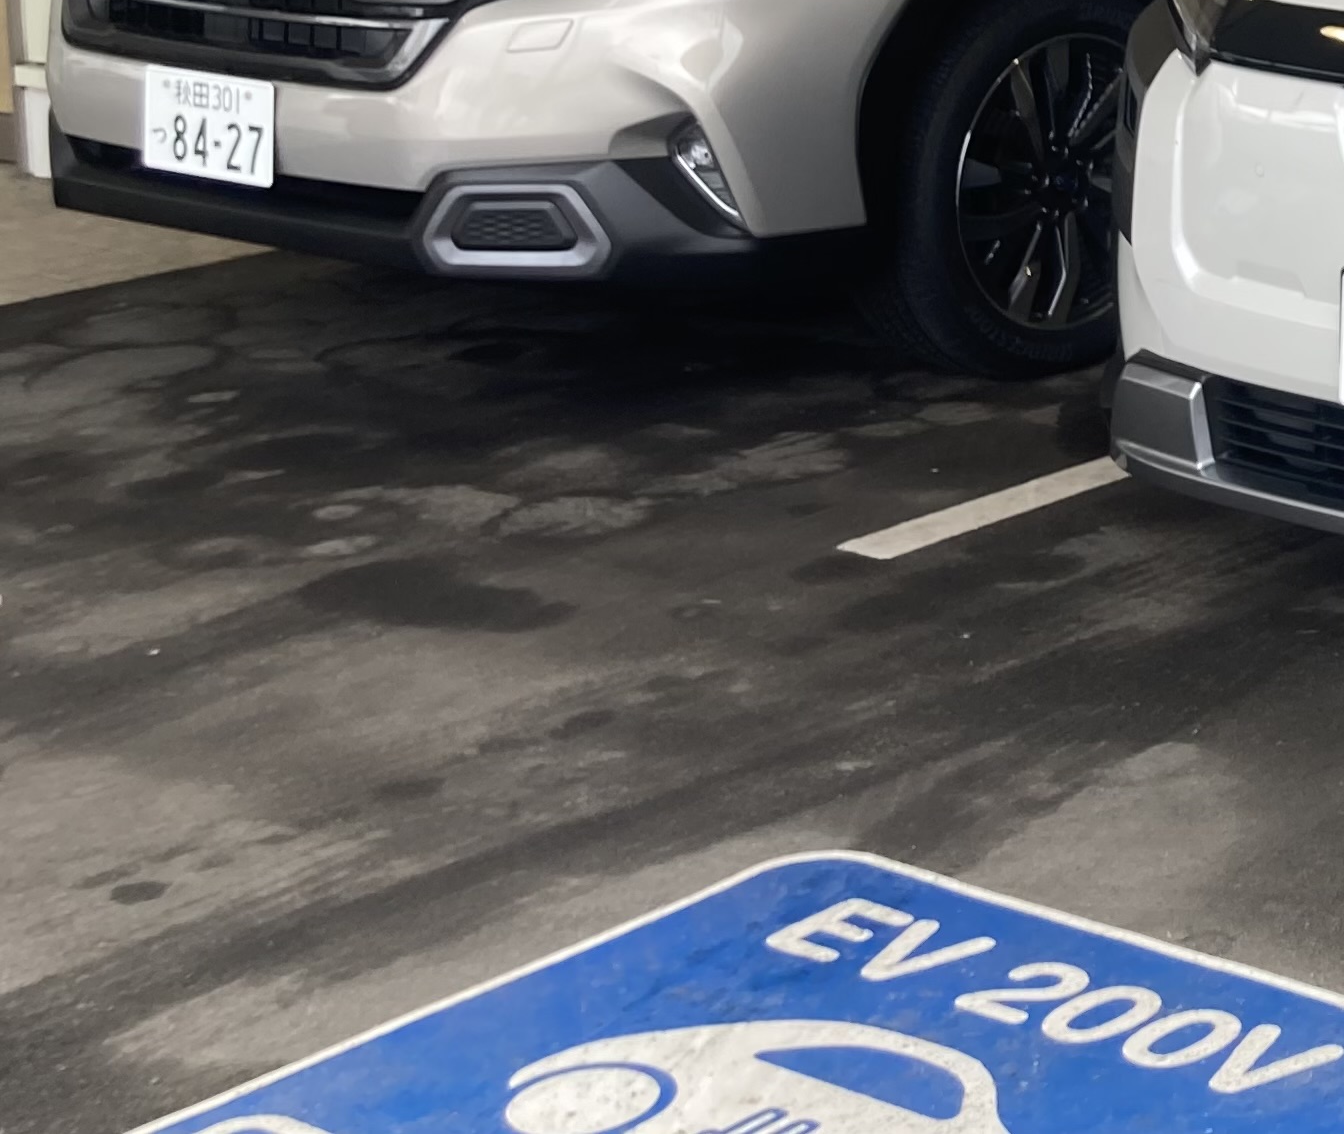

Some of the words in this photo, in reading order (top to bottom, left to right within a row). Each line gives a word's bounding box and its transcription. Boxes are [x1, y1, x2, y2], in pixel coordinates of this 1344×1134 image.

[173, 115, 263, 175] 84-27
[765, 897, 997, 982] EV
[954, 961, 1344, 1094] 200V
